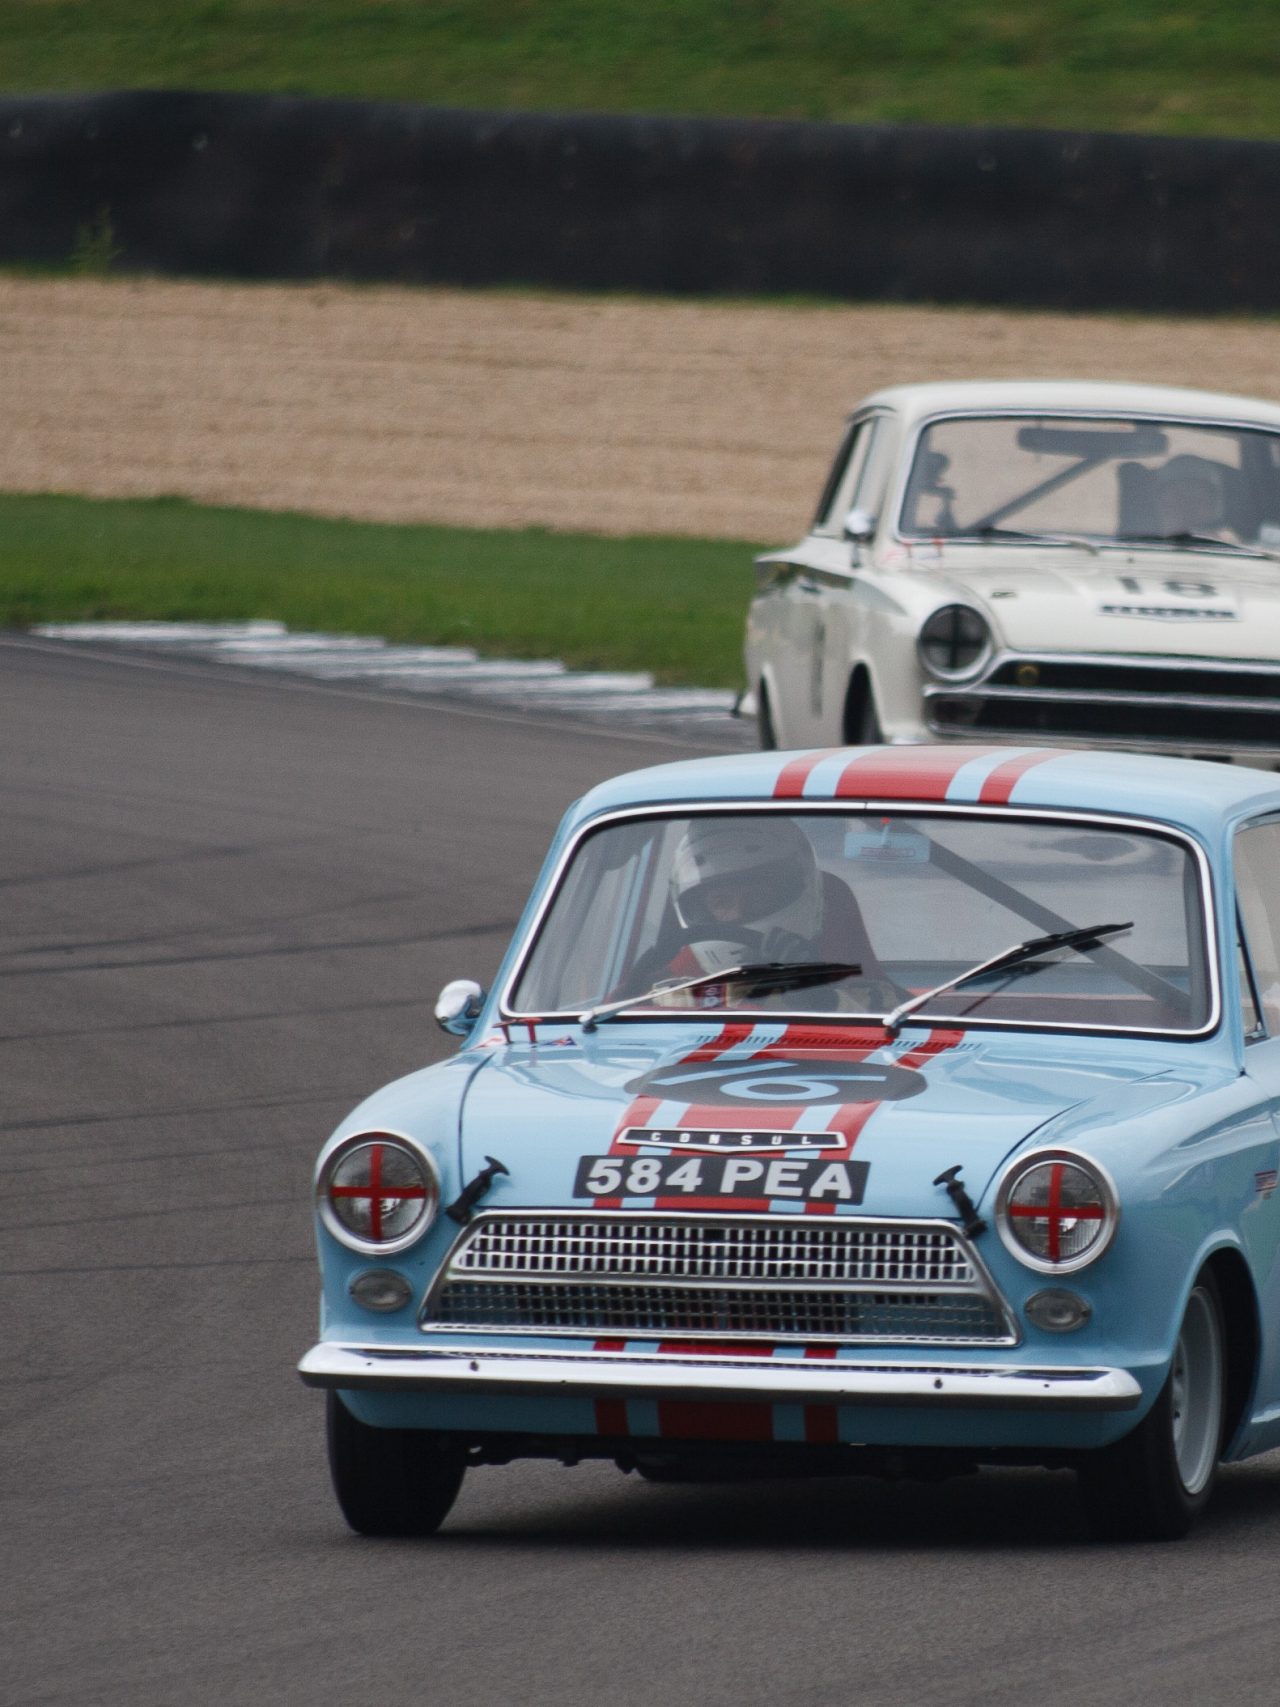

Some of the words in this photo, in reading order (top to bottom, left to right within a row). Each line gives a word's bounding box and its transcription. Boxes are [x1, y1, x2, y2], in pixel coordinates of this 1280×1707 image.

[649, 1061, 887, 1100] 16
[650, 1130, 812, 1146] CONSUL
[585, 1158, 703, 1195] 584
[719, 1159, 853, 1200] PEA
